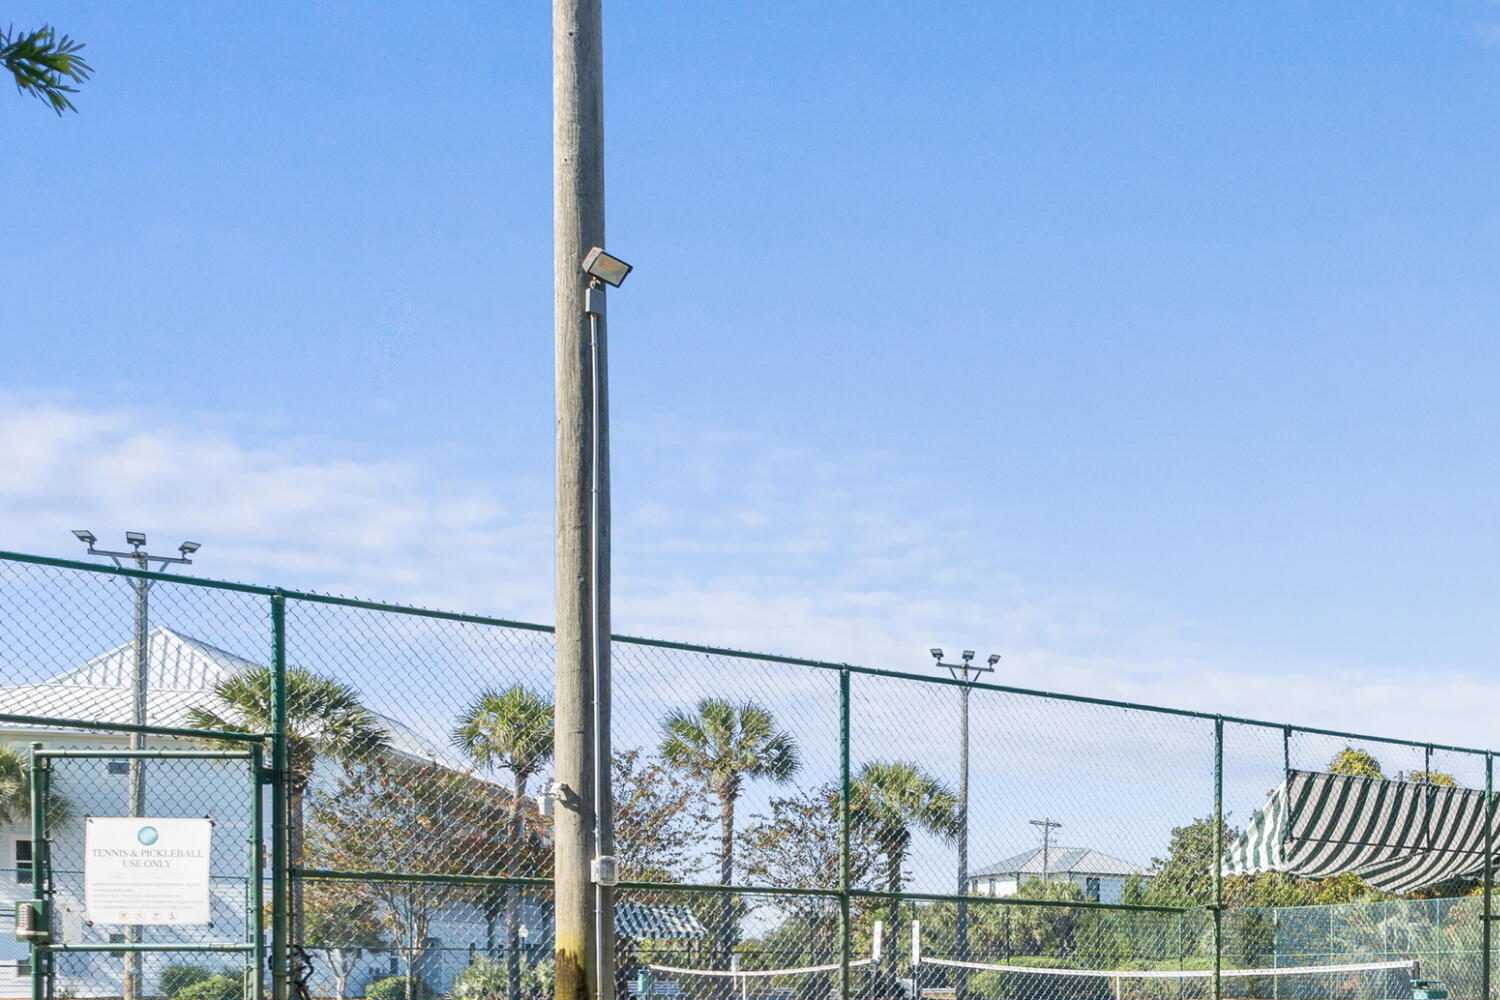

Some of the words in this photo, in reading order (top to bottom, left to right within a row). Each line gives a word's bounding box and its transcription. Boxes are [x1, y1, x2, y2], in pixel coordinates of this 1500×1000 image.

[92, 849, 128, 858] TENNIS
[129, 849, 138, 858] &
[140, 849, 204, 858] PICKLEBALL
[122, 859, 142, 868] USE
[143, 859, 172, 868] ONLY
